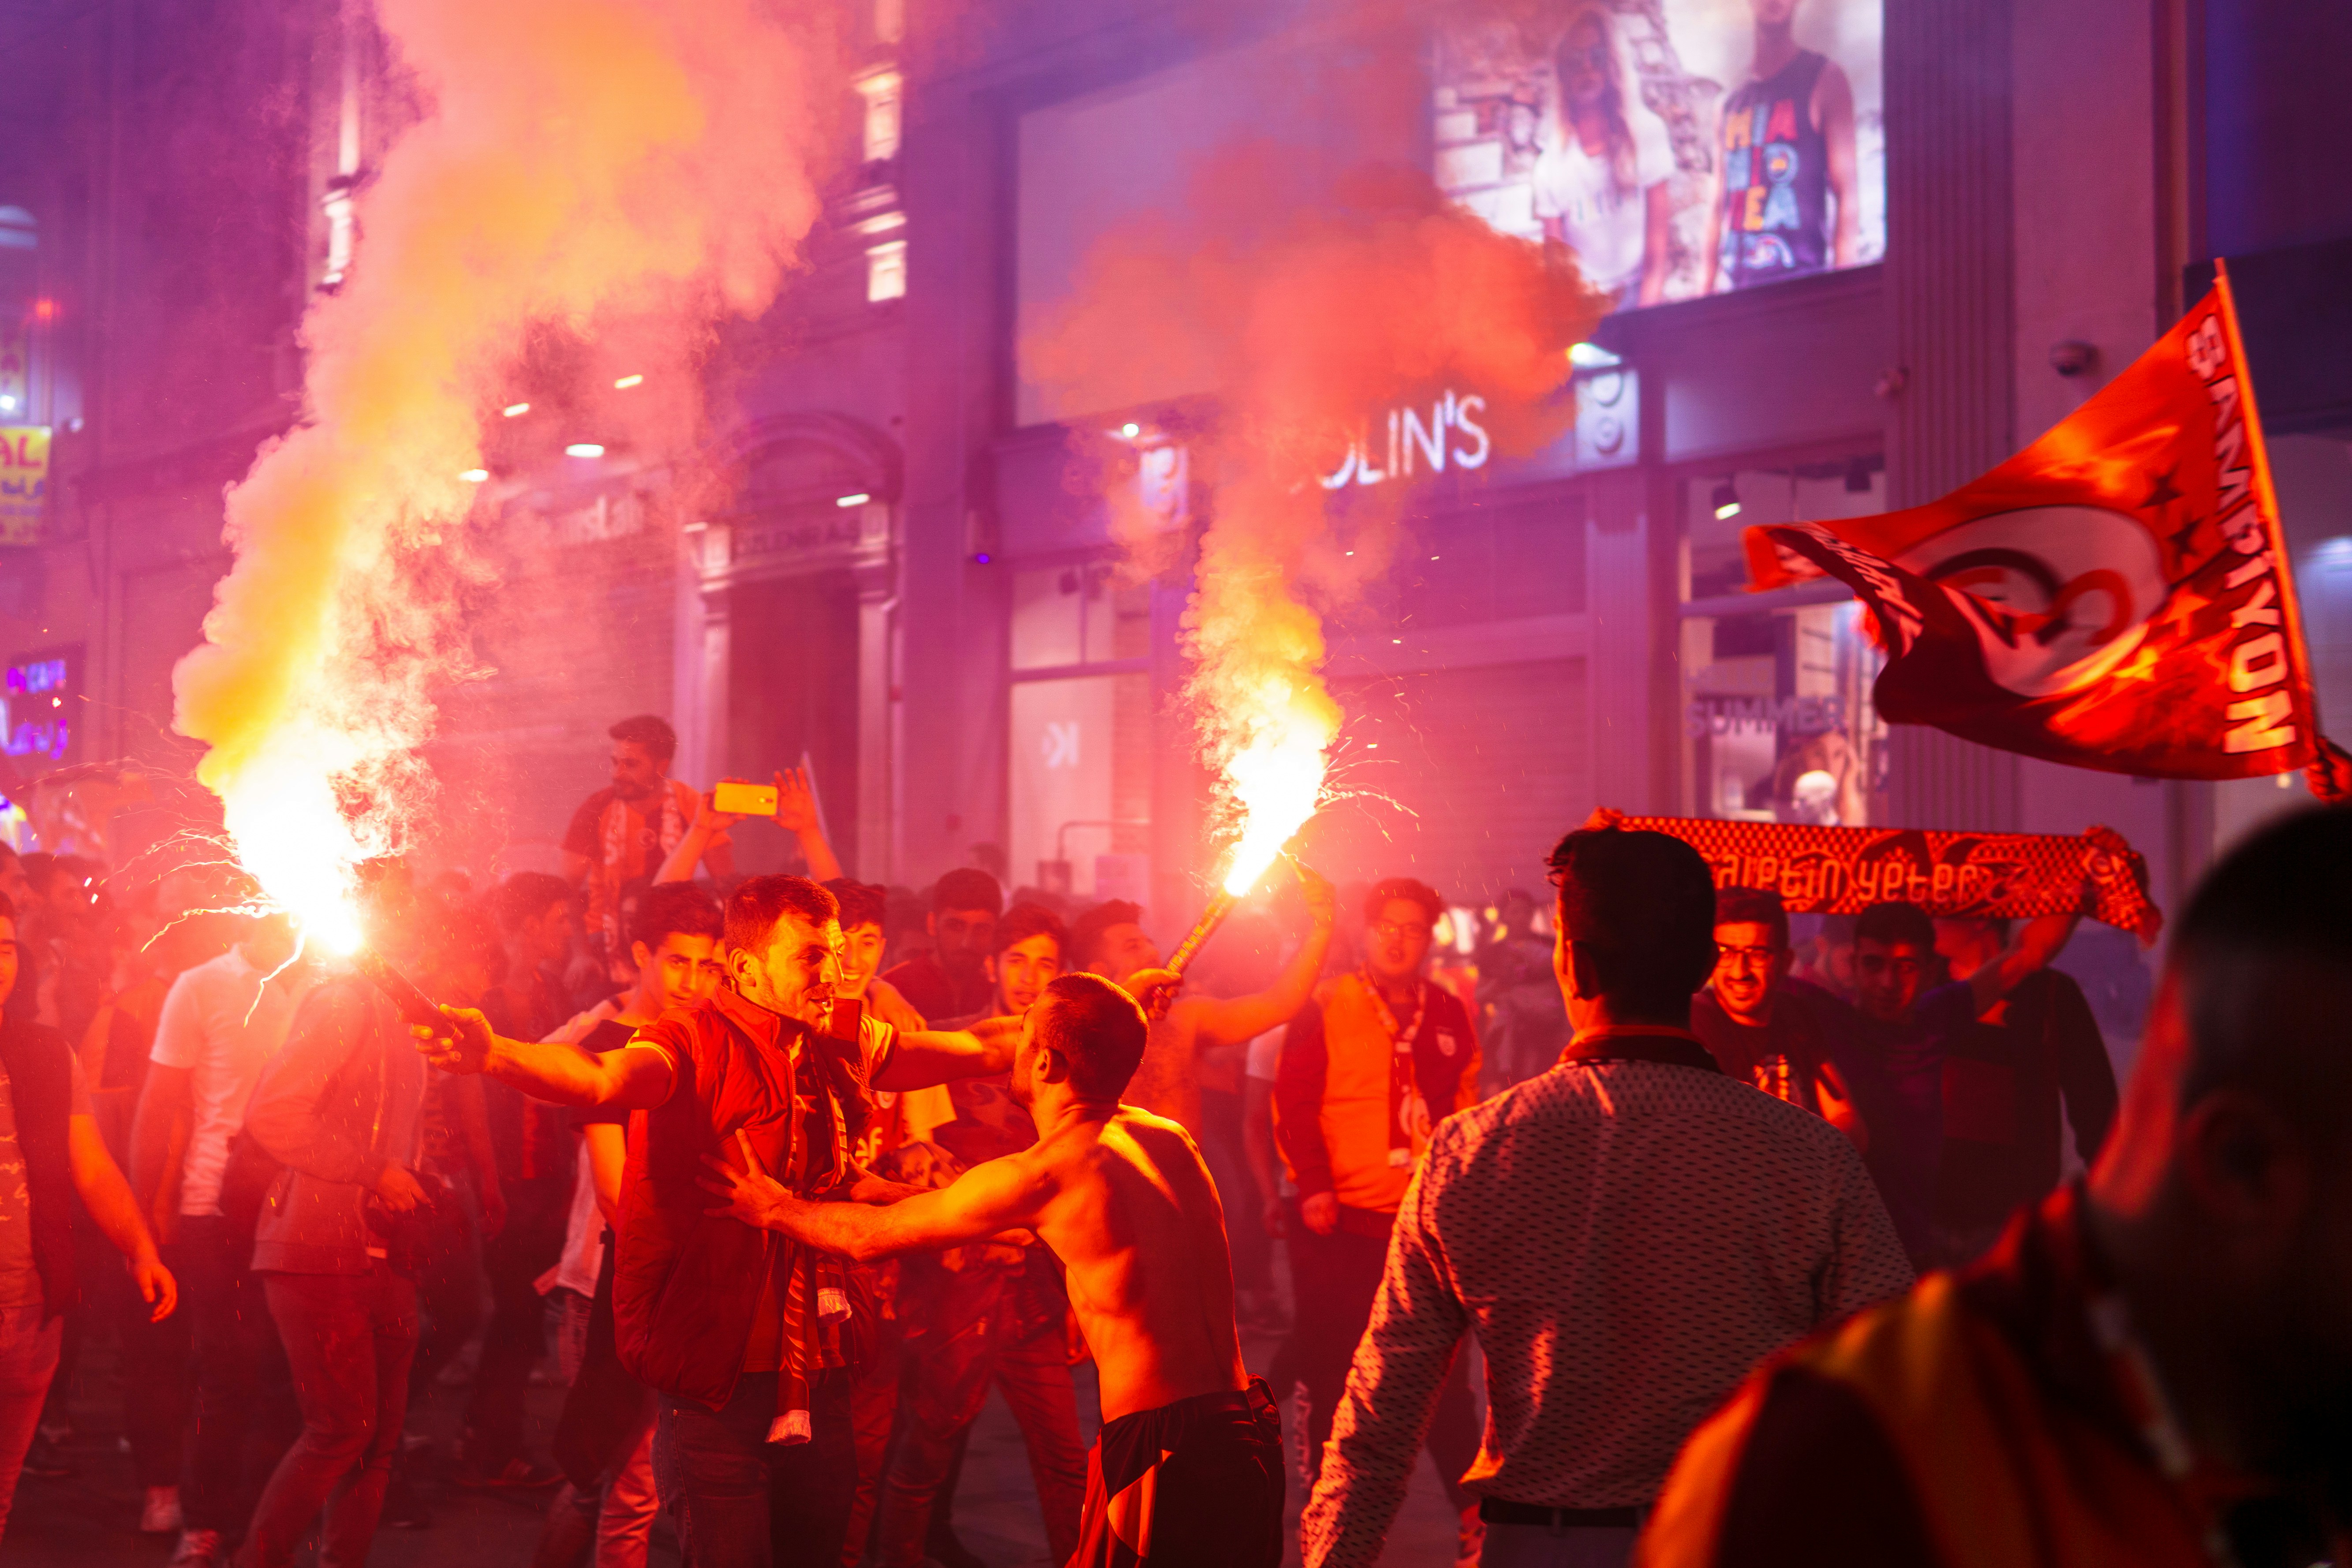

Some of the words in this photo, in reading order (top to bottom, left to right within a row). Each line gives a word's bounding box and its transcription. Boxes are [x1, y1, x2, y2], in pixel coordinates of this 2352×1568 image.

[1288, 388, 1490, 495] LIN'S
[1686, 696, 1848, 738] SUMMER
[1858, 859, 1978, 902] yeter
